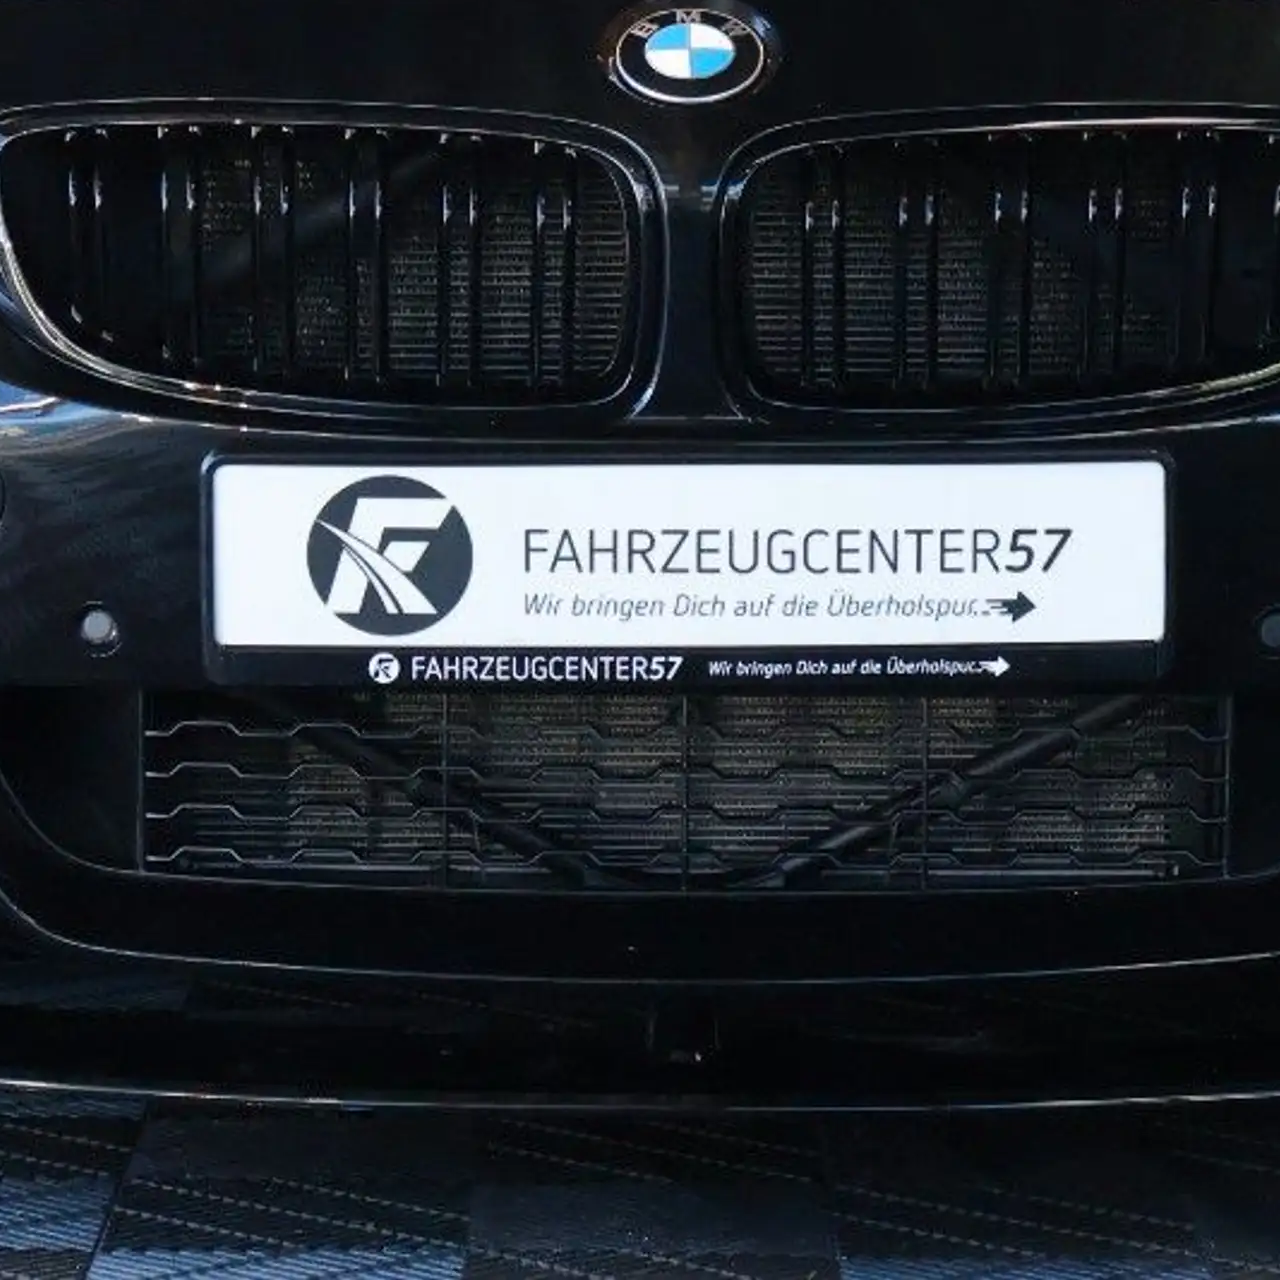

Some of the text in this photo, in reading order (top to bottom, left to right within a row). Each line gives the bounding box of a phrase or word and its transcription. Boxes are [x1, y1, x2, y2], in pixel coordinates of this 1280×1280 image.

[630, 9, 752, 39] BMW
[523, 528, 1074, 575] FAHRZEUGCENTER57
[524, 592, 563, 616] Wir
[571, 593, 665, 621] bringen
[673, 593, 726, 618] Dich
[733, 594, 776, 618] auf
[782, 594, 819, 617] die
[410, 655, 685, 682] FAHRZEUGCENTER57
[708, 660, 733, 677] Wir
[735, 659, 793, 679] bringen
[795, 660, 830, 676] Dich
[831, 659, 858, 676] auf
[860, 659, 882, 676] die
